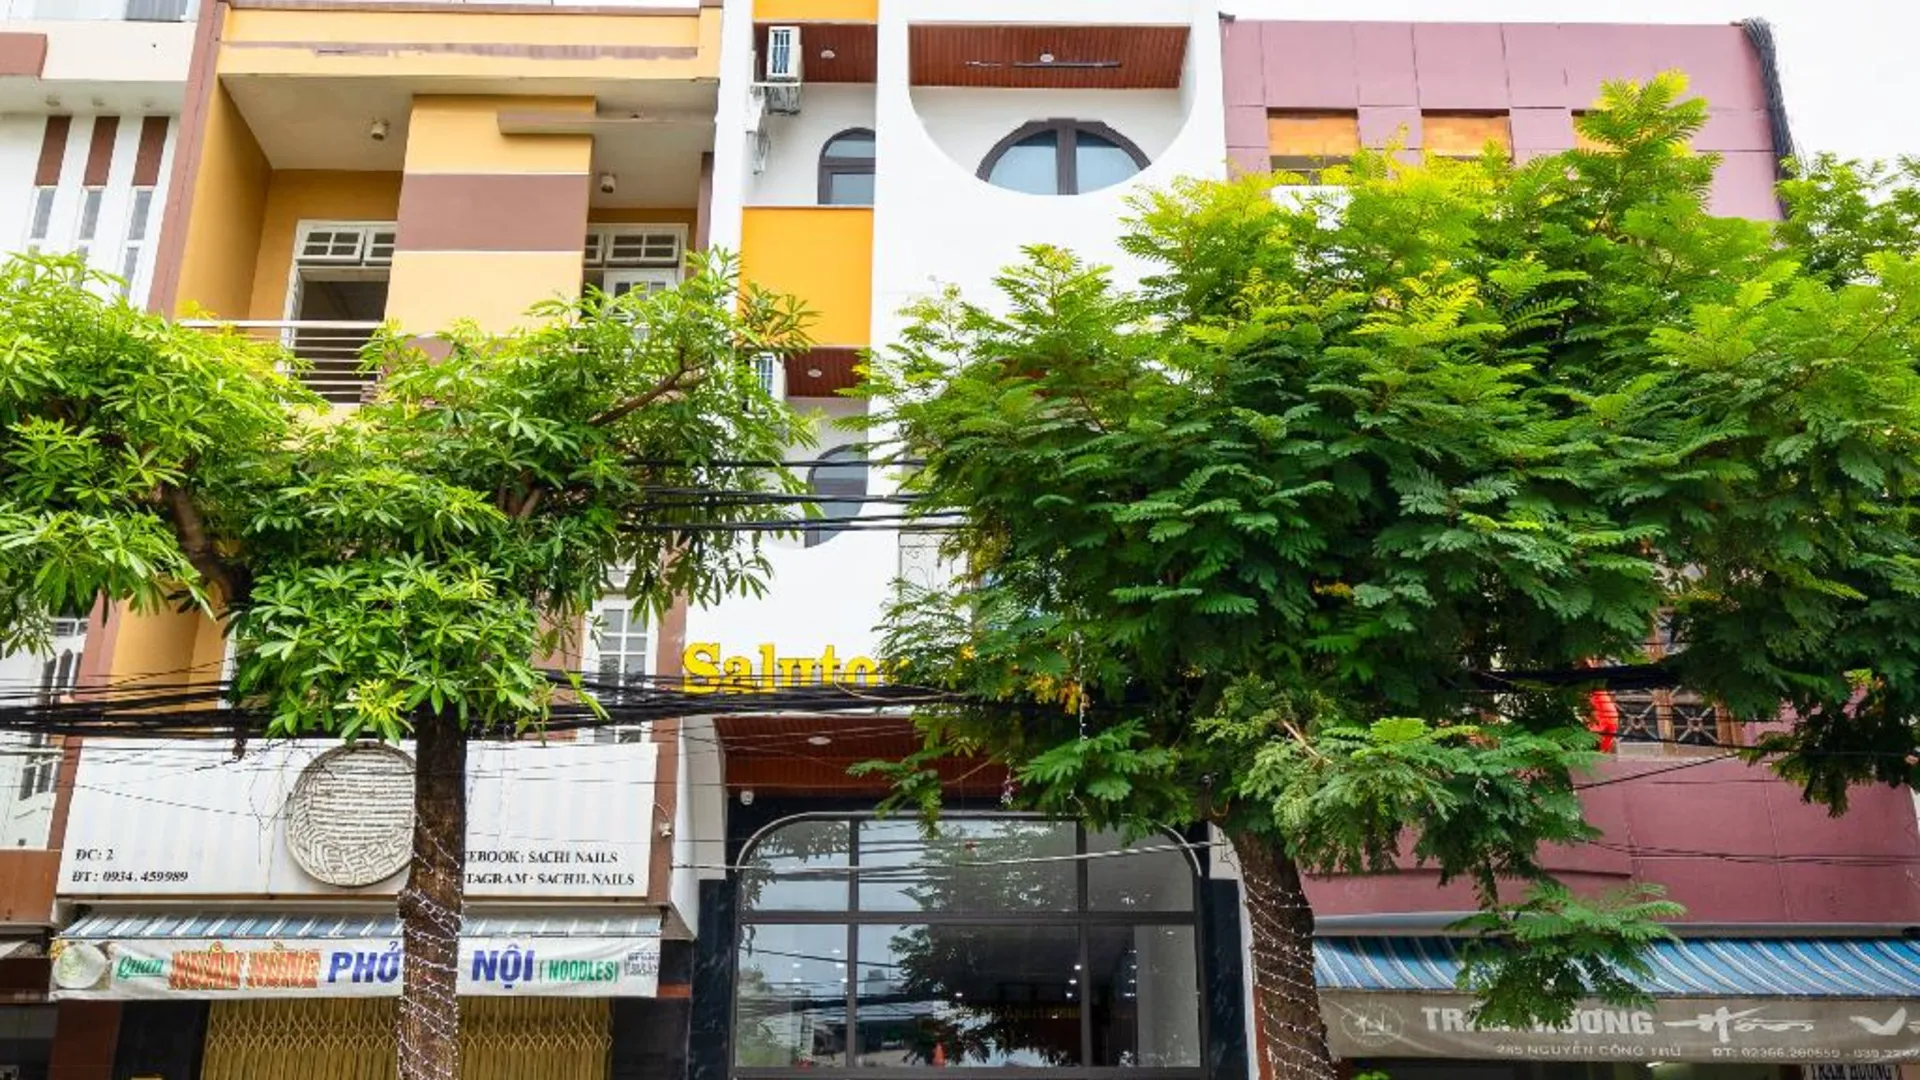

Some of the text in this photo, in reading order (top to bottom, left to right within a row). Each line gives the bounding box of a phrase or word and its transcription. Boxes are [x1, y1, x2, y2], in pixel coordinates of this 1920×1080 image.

[106, 849, 114, 860] 2
[528, 851, 570, 863] SACHI
[575, 851, 618, 863] NAILS
[328, 941, 402, 983] PHỞ
[472, 943, 535, 989] NỘI
